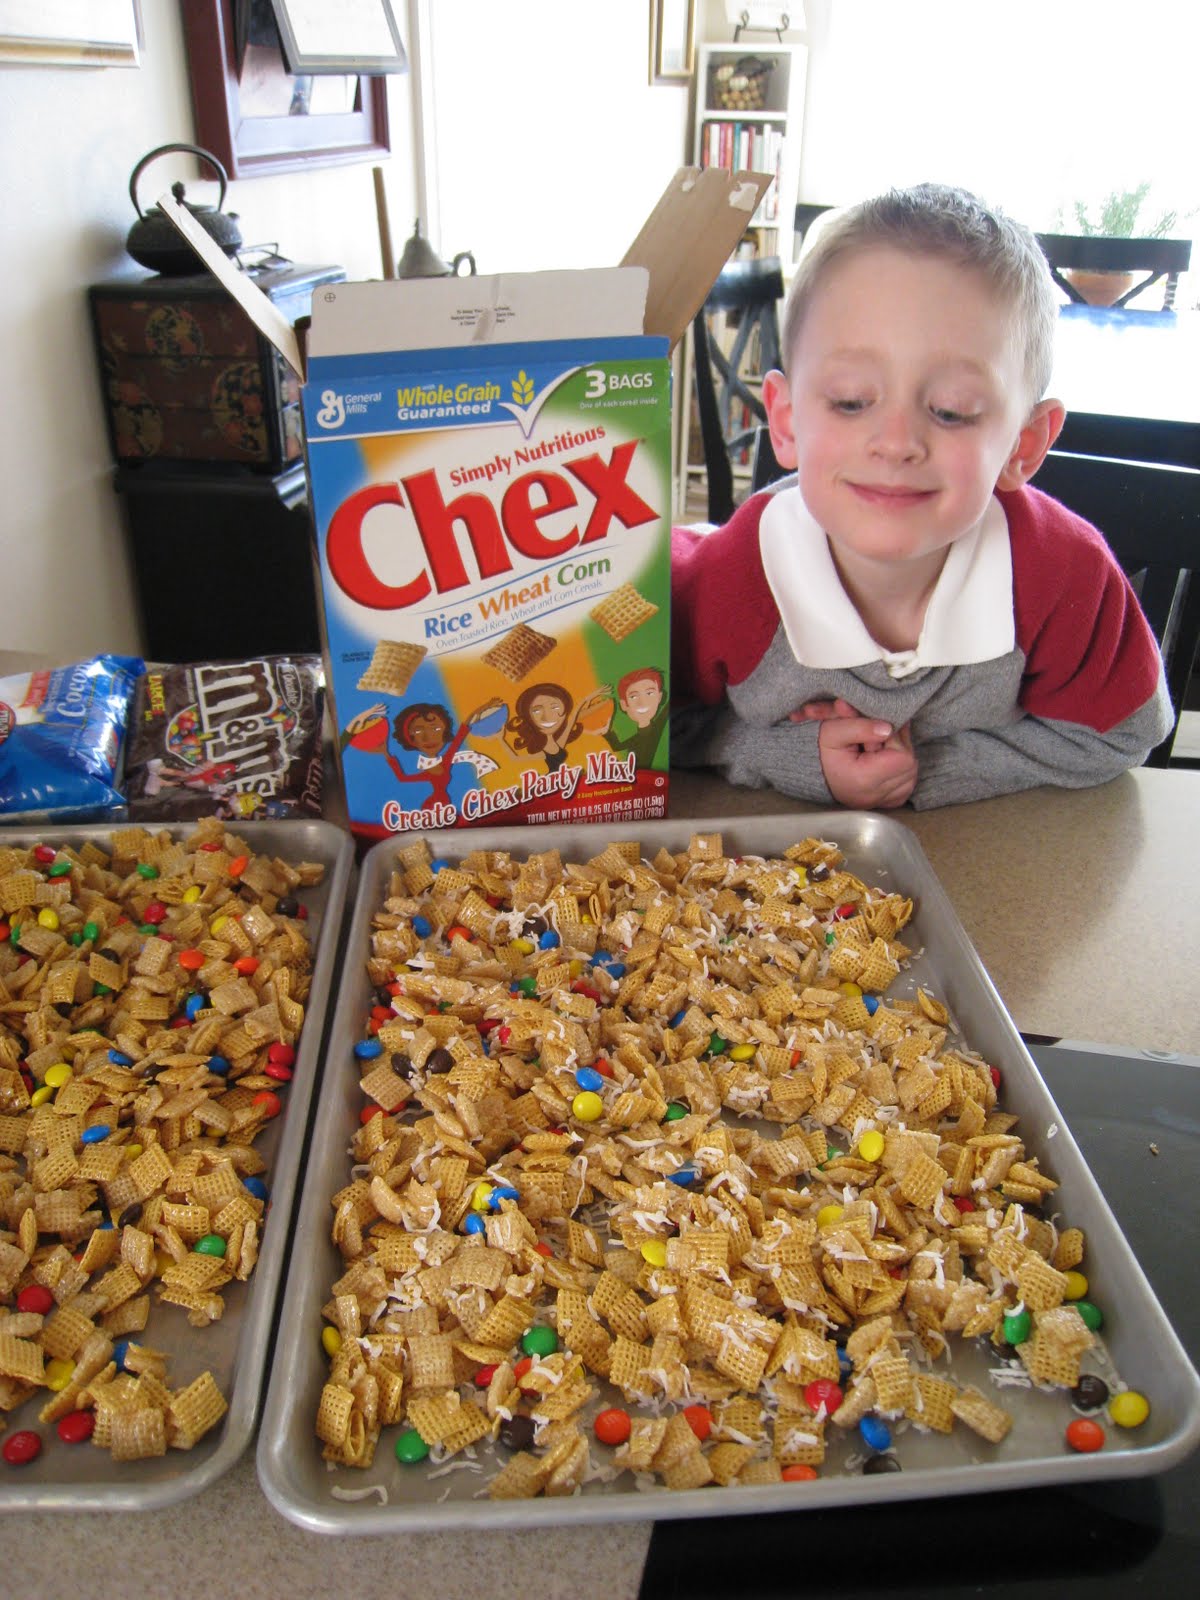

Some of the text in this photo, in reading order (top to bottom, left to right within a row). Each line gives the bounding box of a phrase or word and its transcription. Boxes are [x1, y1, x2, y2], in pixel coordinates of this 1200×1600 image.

[396, 381, 501, 408] Whole Grain
[585, 370, 653, 398] 3 BAGS
[345, 392, 382, 405] General
[345, 403, 368, 415] Mills
[397, 400, 492, 421] Guaranteed
[450, 426, 606, 487] Simply Nutritious
[326, 440, 661, 611] Chex
[424, 558, 611, 639] Rice Wheat Corn
[436, 637, 460, 650] Oven
[460, 623, 489, 640] Toasted
[510, 604, 537, 621] Wheat
[538, 595, 553, 609] and
[148, 675, 165, 711] LARGE
[382, 750, 636, 831] Create Chex Party Mix!
[594, 788, 613, 797] Recipes
[621, 785, 633, 793] Back
[527, 812, 546, 824] TOTAL
[548, 810, 560, 822] NET
[562, 808, 571, 820] WT
[572, 807, 577, 818] 3
[578, 806, 587, 817] LB
[603, 803, 611, 814] OZ
[612, 800, 632, 813] (54.25
[633, 798, 644, 809] OZ)
